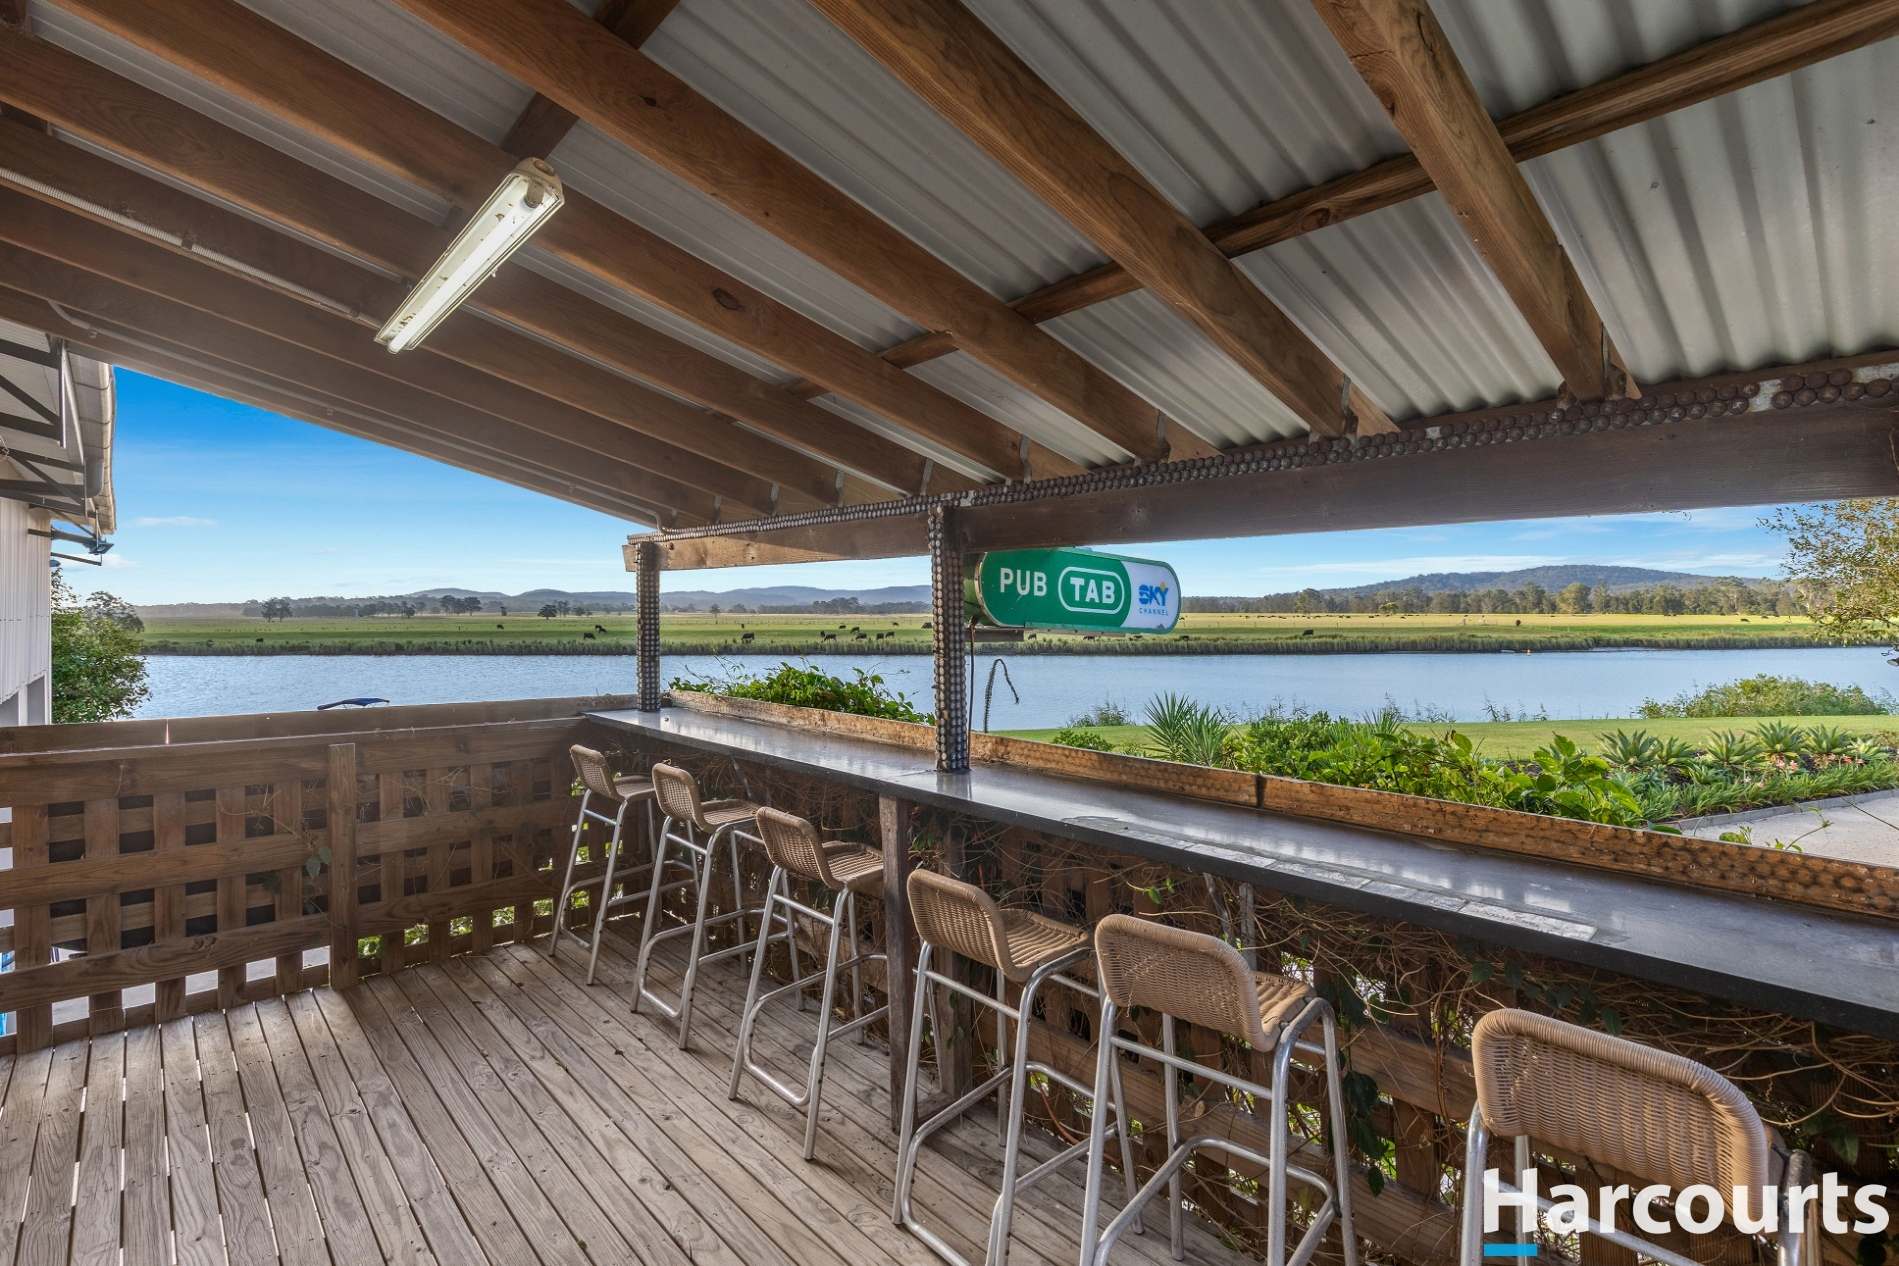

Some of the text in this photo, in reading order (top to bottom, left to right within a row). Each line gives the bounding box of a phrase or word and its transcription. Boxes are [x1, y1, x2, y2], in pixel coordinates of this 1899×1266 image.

[1000, 568, 1115, 604] PUB TAB
[1138, 584, 1169, 606] SKY
[1138, 607, 1169, 616] CHANNEL
